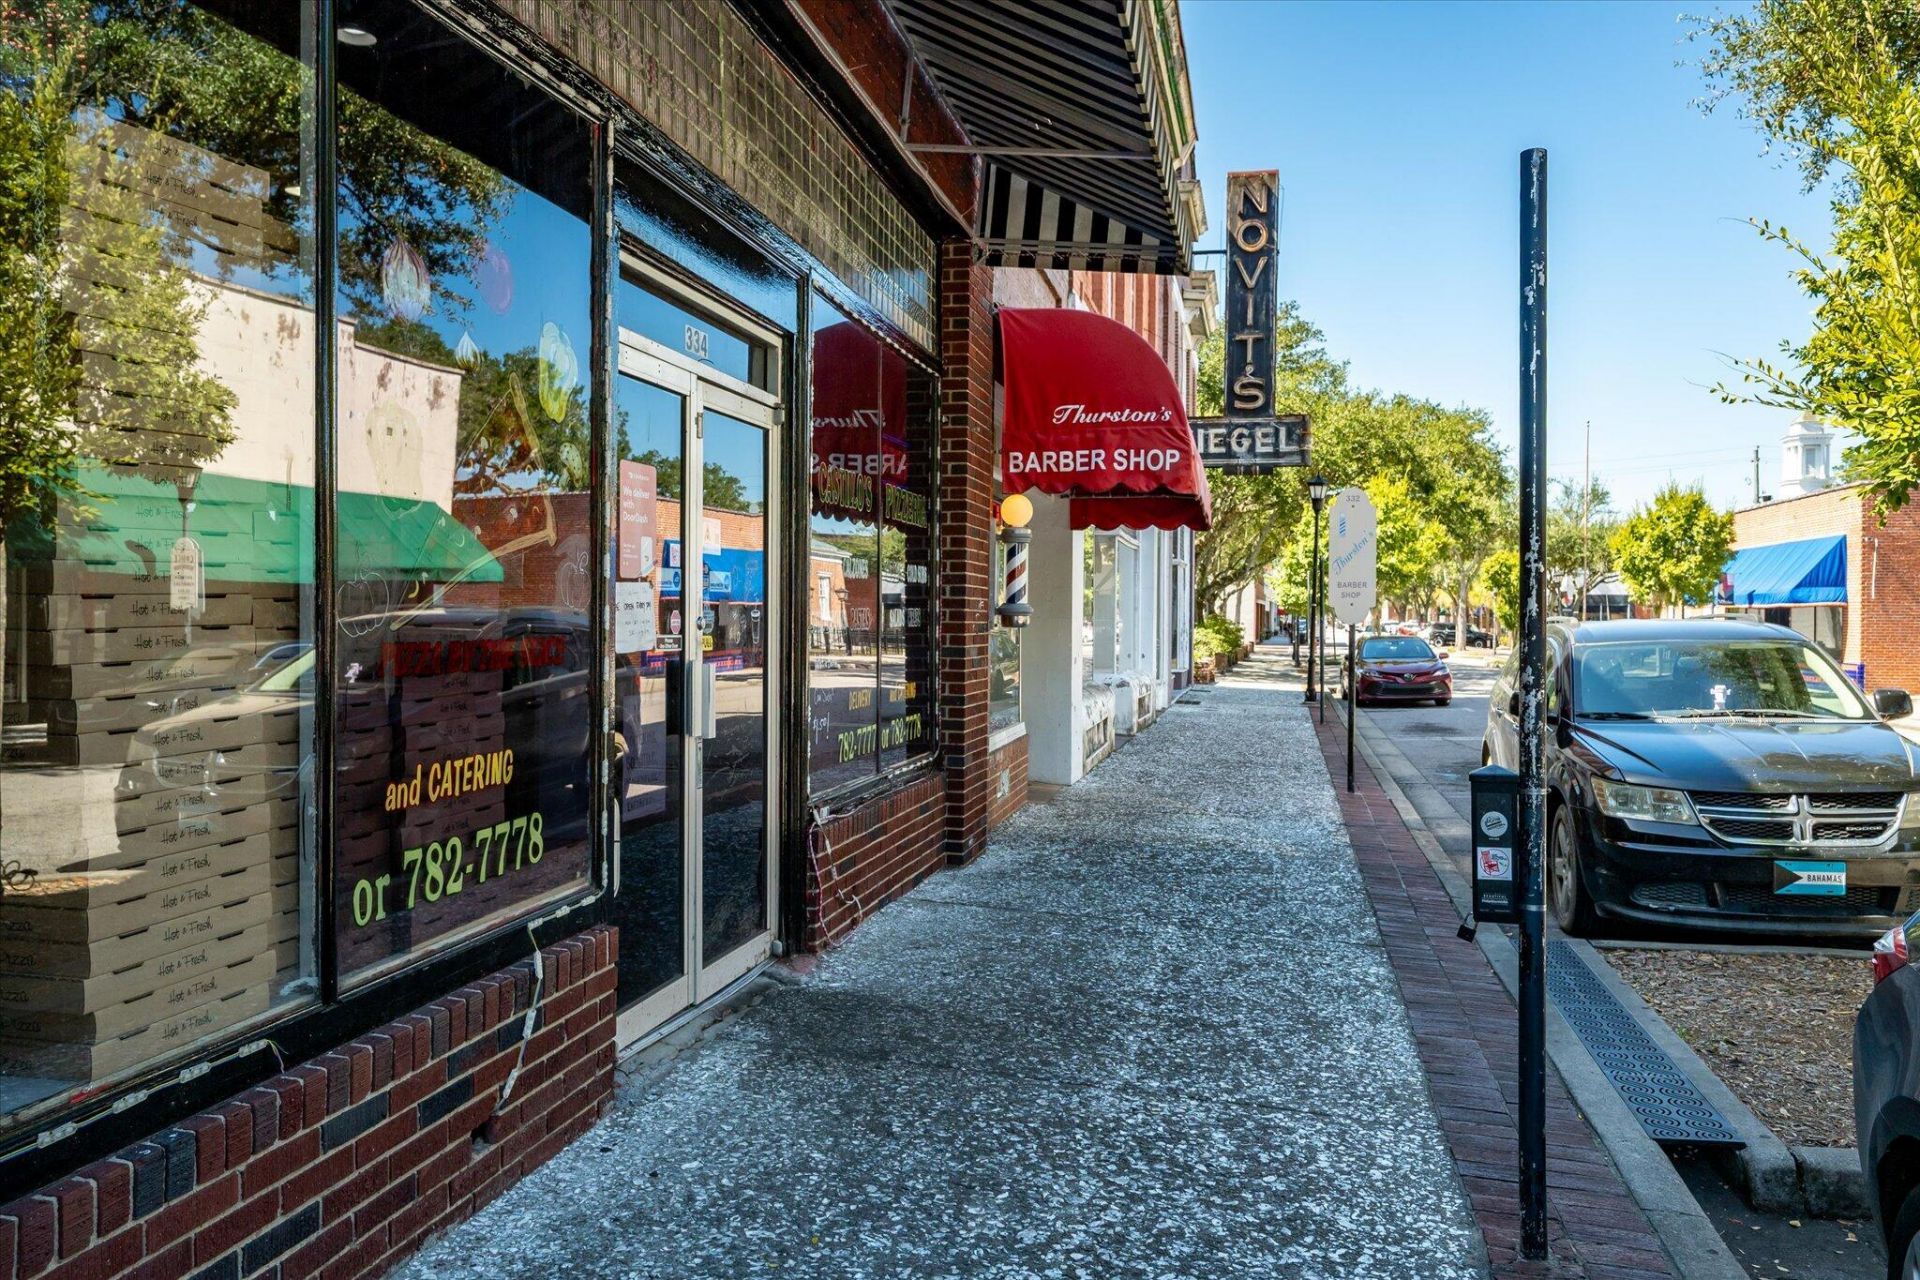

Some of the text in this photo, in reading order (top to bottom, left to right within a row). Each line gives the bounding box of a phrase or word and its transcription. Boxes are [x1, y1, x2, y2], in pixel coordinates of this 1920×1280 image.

[1233, 175, 1269, 410] NOVIT'S
[686, 326, 708, 358] 334
[1052, 404, 1173, 425] Thurston's
[1197, 426, 1299, 453] IEGEL
[1009, 448, 1181, 474] BARBER SHOP
[818, 461, 873, 513] CASTILLO'S
[1337, 581, 1368, 589] BARBER
[881, 728, 889, 749] or
[384, 749, 514, 812] and CATERING
[353, 812, 544, 927] or 782-7778
[1807, 874, 1842, 882] BAHAMAS
